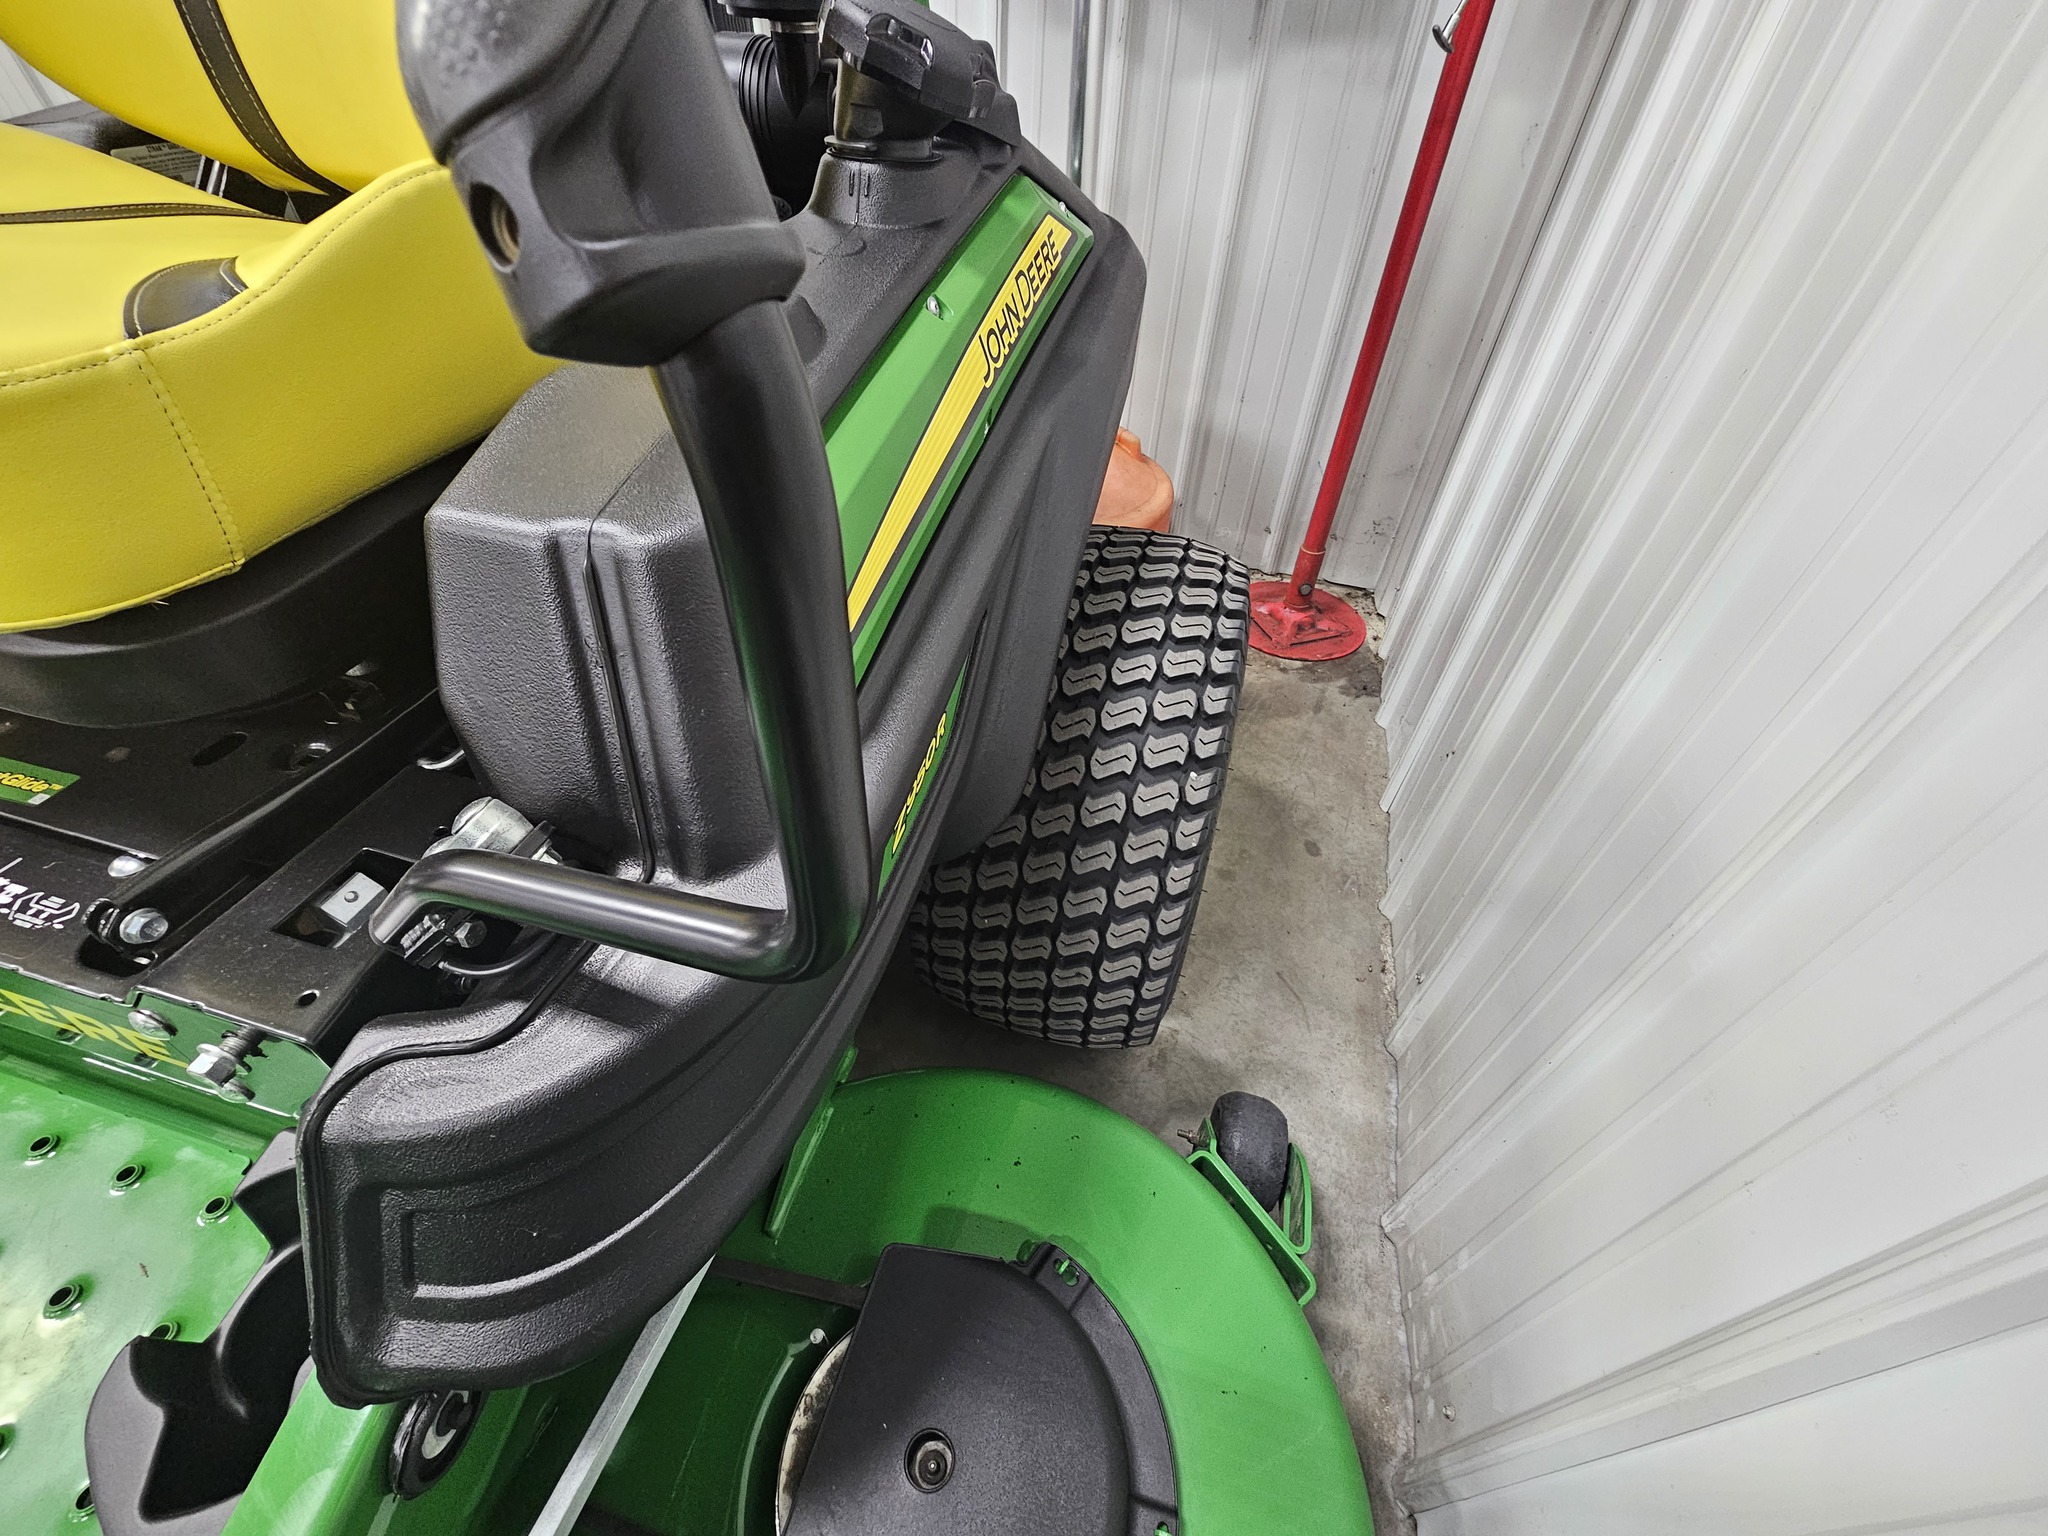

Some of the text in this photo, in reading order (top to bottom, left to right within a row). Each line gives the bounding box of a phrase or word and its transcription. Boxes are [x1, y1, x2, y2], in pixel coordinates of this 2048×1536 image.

[978, 228, 1060, 384] JOHN DEERE
[892, 712, 946, 855] Z950R
[0, 988, 188, 1068] ERE
